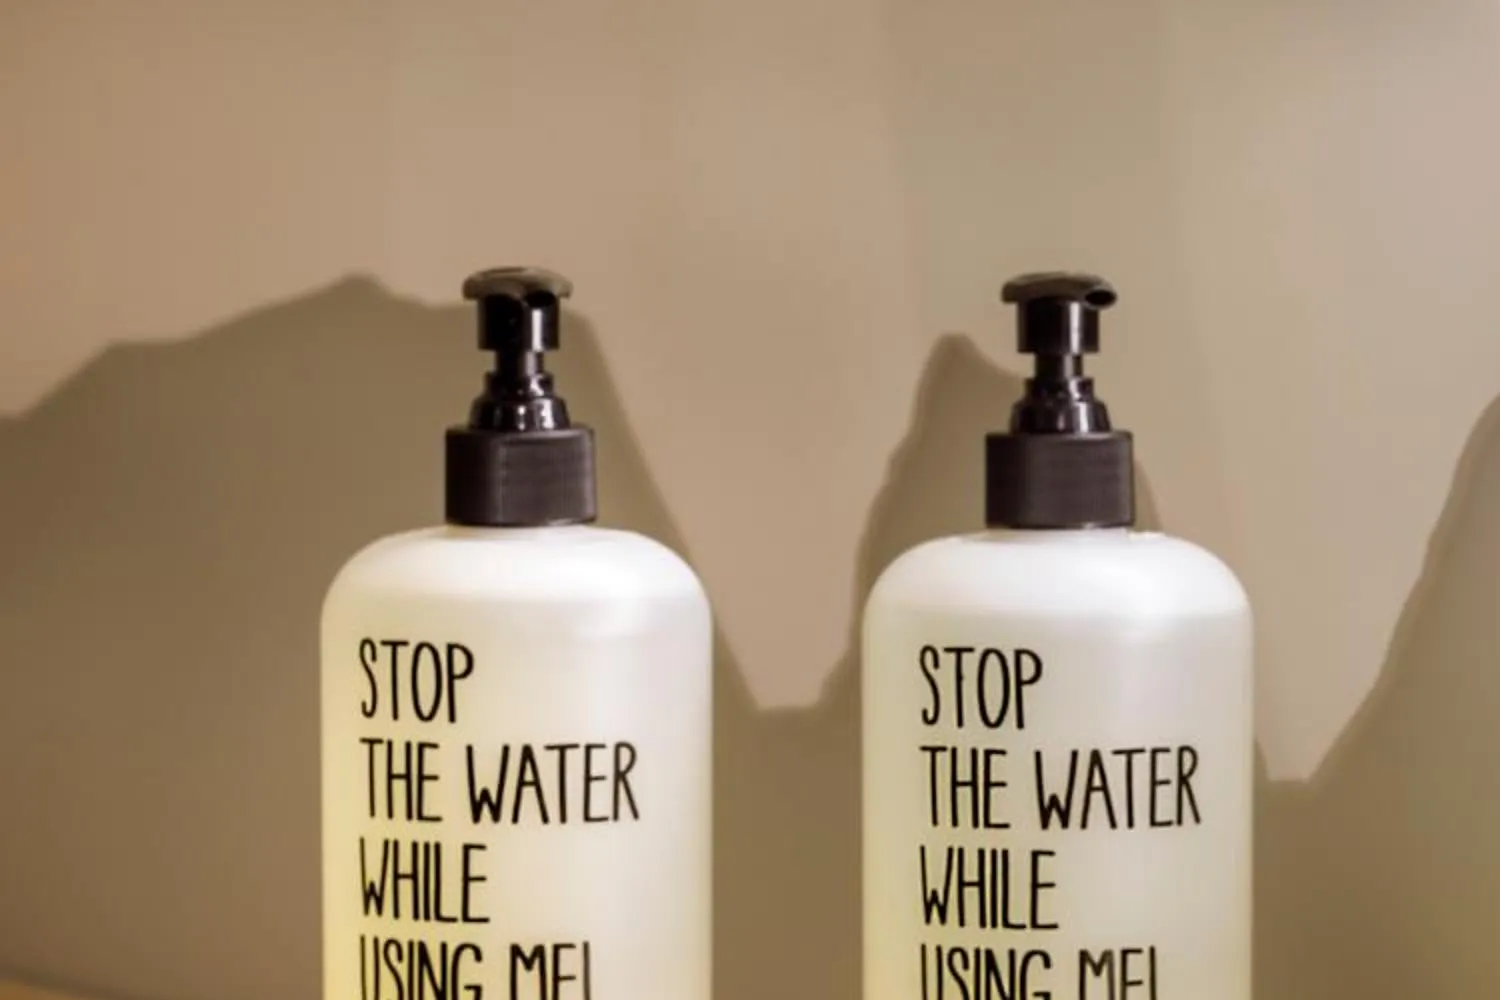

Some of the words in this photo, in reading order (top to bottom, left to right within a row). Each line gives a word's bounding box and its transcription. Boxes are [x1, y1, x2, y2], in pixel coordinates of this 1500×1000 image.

[360, 637, 474, 723] STOP
[920, 645, 1043, 729] STOP
[360, 738, 442, 821] THE
[466, 741, 639, 824] WATER
[920, 746, 1010, 829] THE
[1035, 745, 1201, 829] WATER
[360, 837, 490, 923] WHILE
[920, 845, 1059, 929] WHILE
